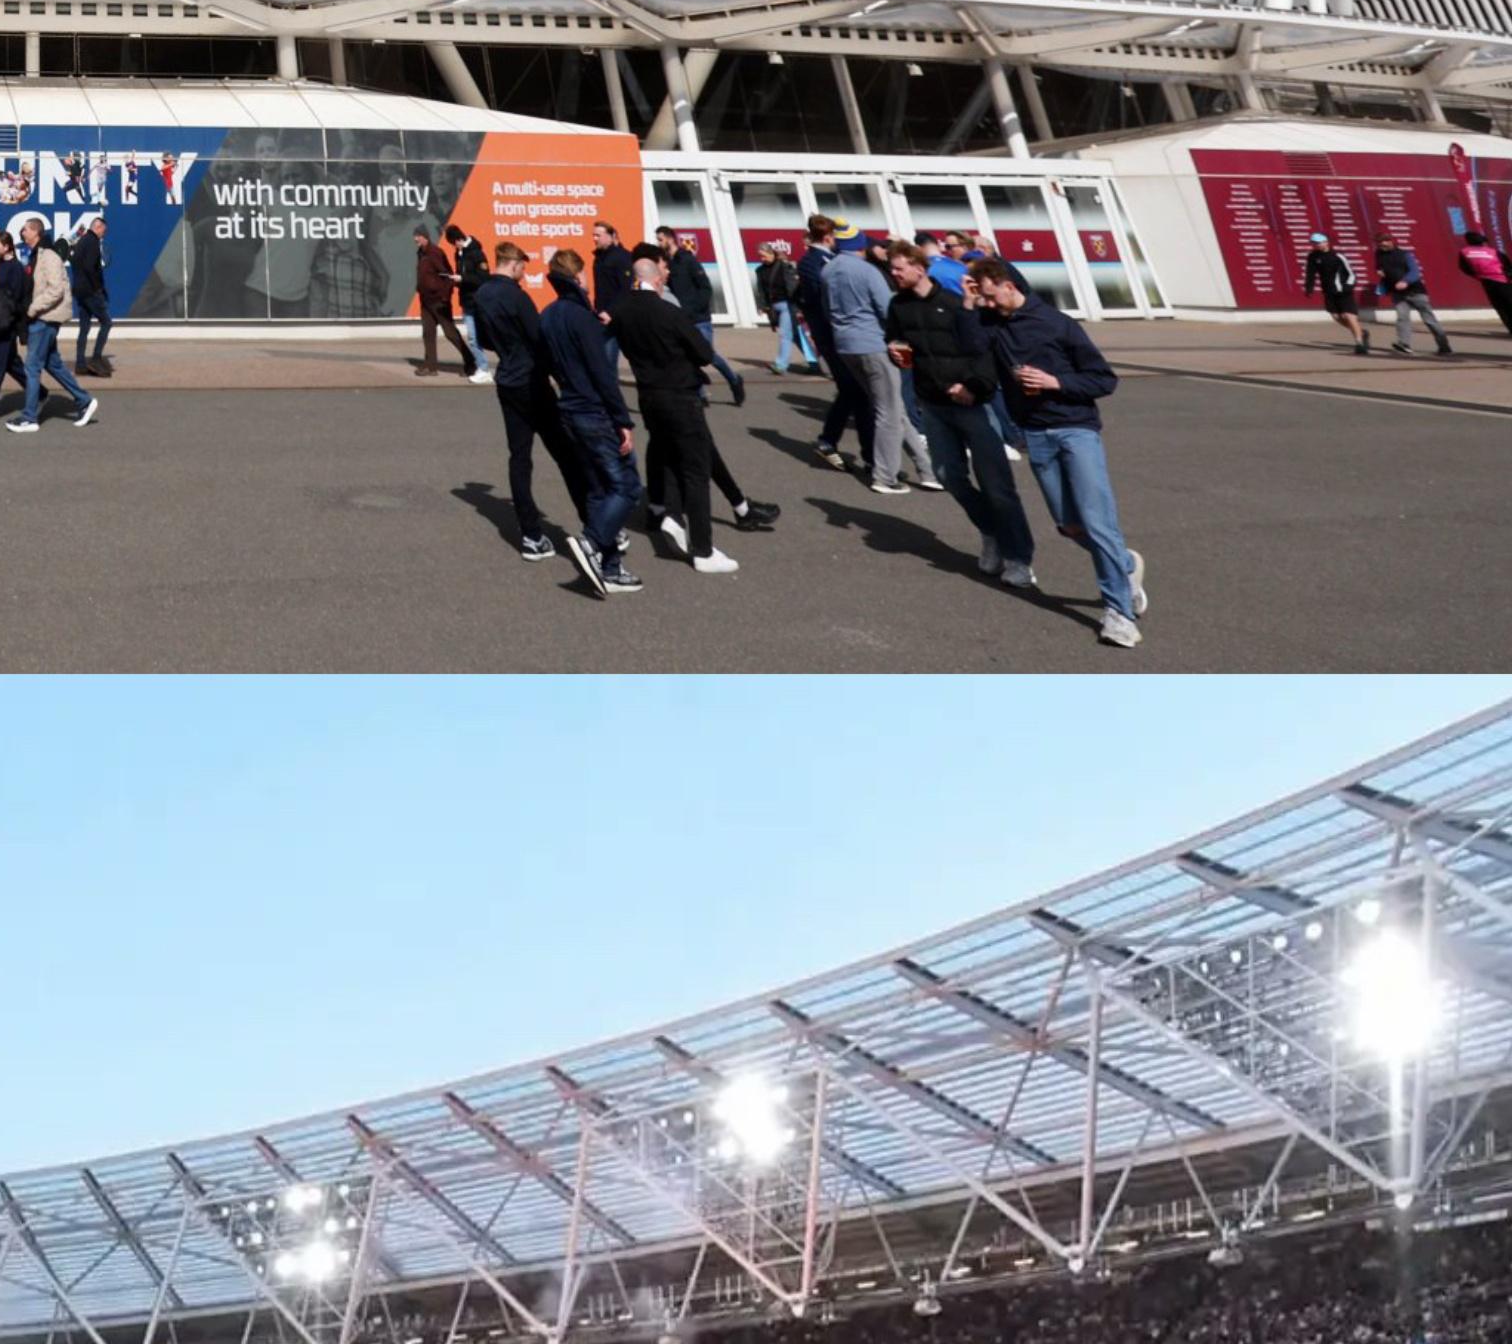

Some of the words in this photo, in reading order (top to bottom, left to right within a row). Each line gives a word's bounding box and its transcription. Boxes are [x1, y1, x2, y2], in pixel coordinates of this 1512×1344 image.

[213, 177, 274, 206] with
[280, 179, 429, 211] community
[492, 181, 503, 196] A
[504, 180, 565, 196] multi-use
[567, 184, 604, 199] space
[494, 200, 526, 216] from
[528, 202, 597, 218] grassroots
[215, 212, 245, 240] at
[250, 210, 285, 240] its
[290, 211, 365, 240] heart
[495, 222, 509, 236] to
[511, 220, 540, 236] elite
[541, 222, 584, 239] sports
